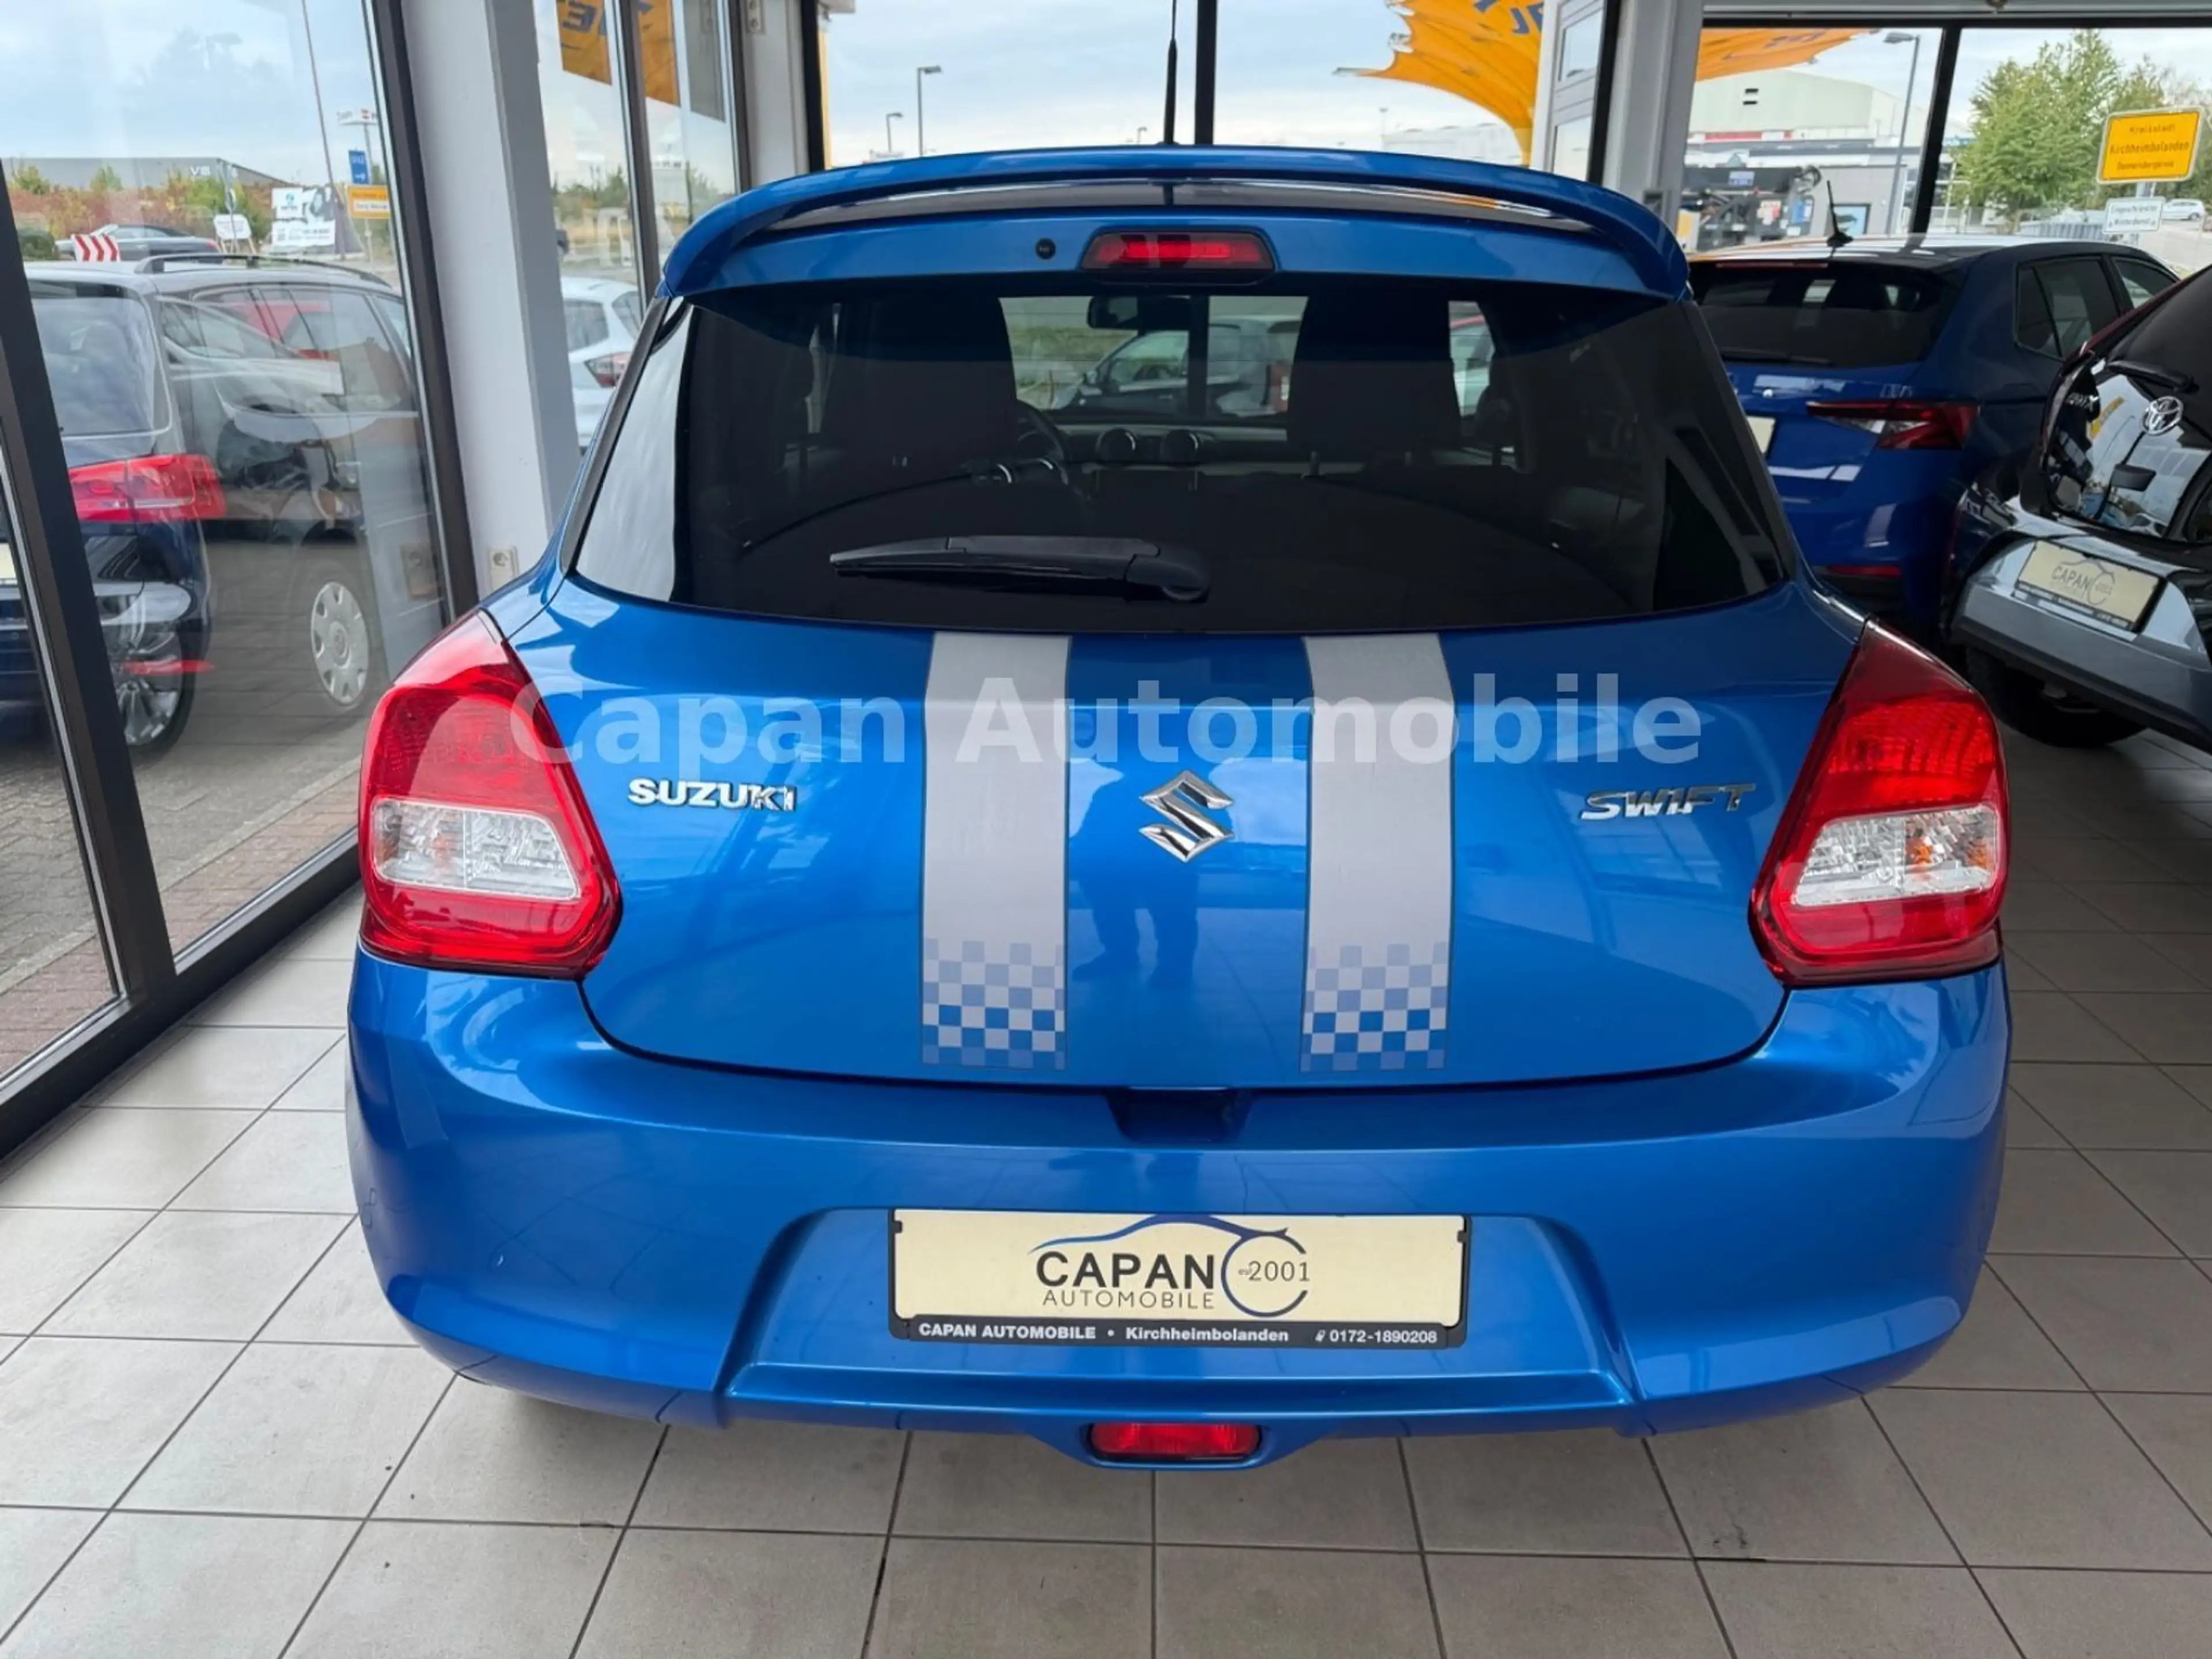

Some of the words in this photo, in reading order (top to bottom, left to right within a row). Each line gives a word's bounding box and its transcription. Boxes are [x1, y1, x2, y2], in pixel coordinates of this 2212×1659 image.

[628, 778, 797, 812] SUZUKI
[1581, 783, 1756, 820] SWIFT
[1036, 1251, 1214, 1289] CAPAN
[1248, 1260, 1310, 1282] 2001
[1042, 1290, 1214, 1309] AUTOMOBILE
[919, 1323, 976, 1338] CAPAN
[982, 1324, 1096, 1339] AUTOMOBILE
[1126, 1327, 1289, 1343] Kirchheimbolanden
[1330, 1329, 1438, 1344] 0172-1890208
